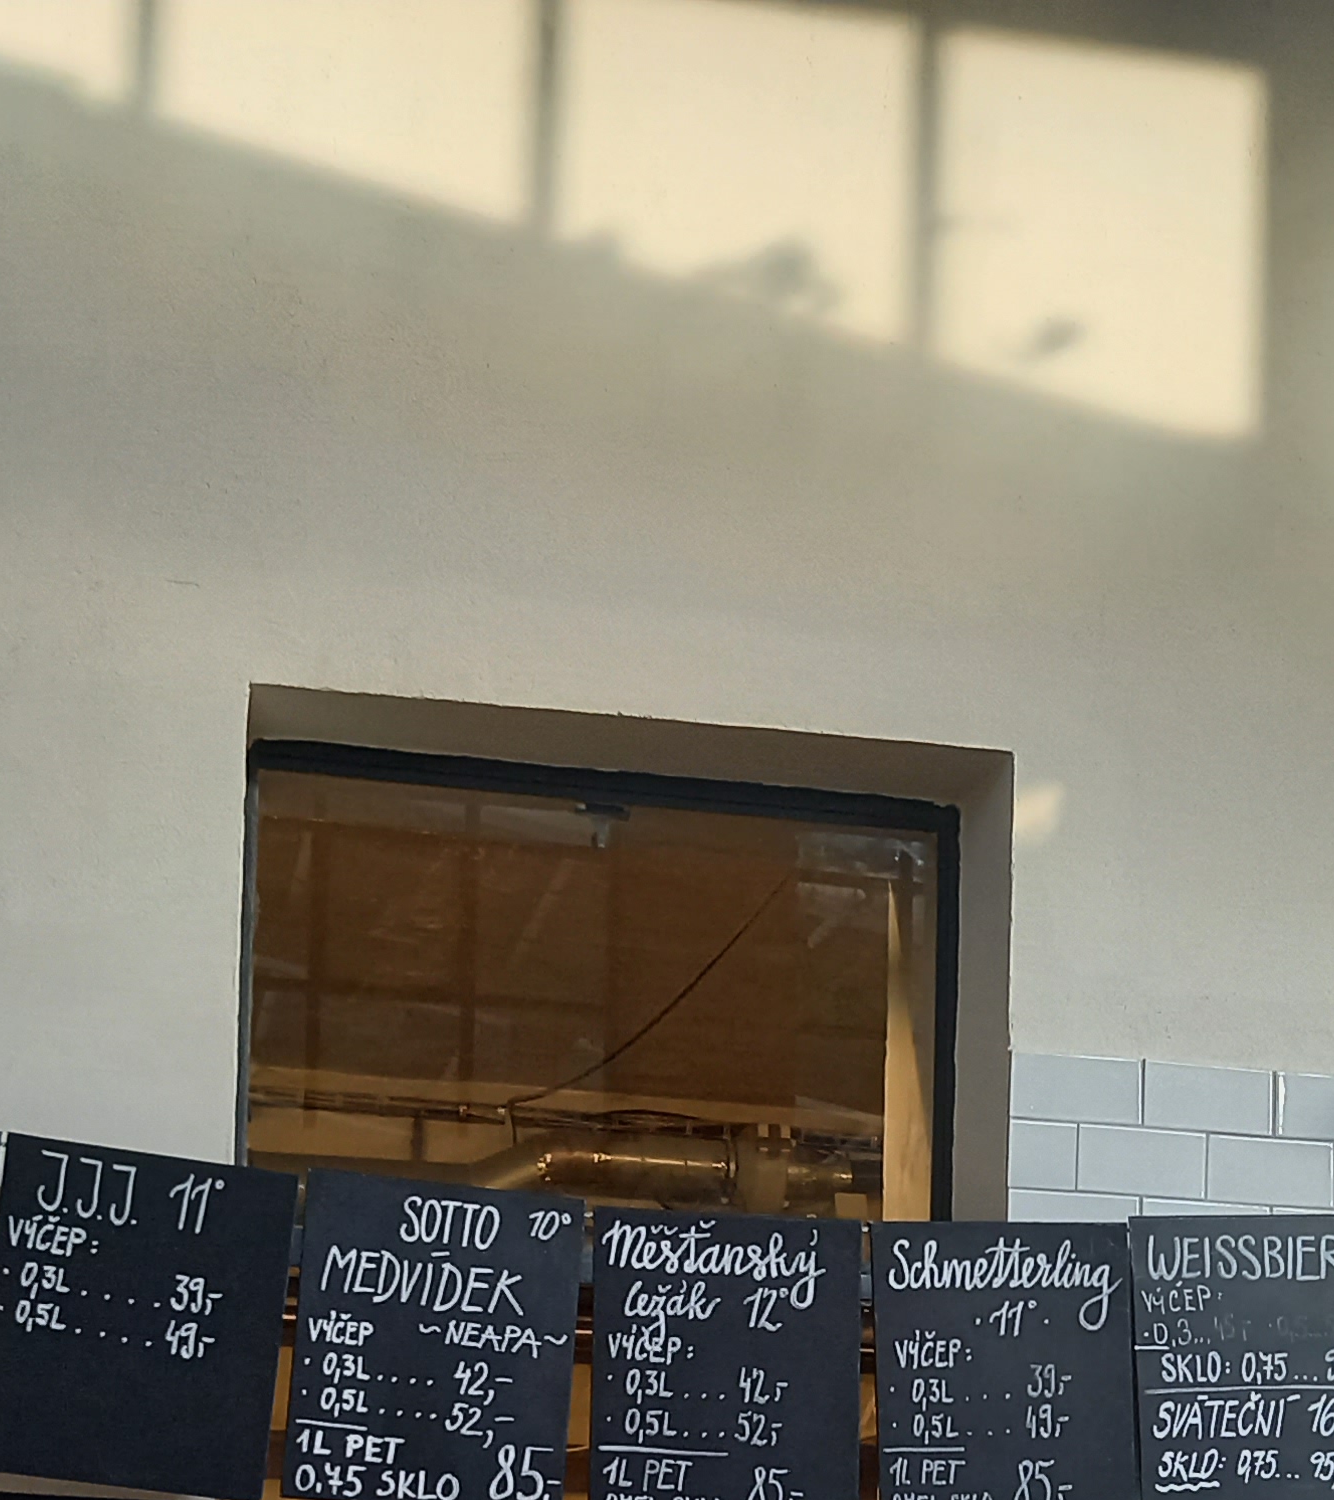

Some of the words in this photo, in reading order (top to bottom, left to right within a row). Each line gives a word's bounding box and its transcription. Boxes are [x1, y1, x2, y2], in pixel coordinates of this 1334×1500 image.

[400, 1196, 500, 1250] SOTTO
[529, 1211, 571, 1240] 10°
[21, 1262, 70, 1297] 0,3L
[321, 1245, 523, 1321] MEDVÍDEK
[889, 1237, 1122, 1335] Schmetterling
[16, 1300, 66, 1332] 0,5L
[743, 1288, 789, 1331] 12°
[309, 1310, 373, 1346] VÝČEP
[323, 1352, 370, 1384] 0,3L
[1242, 1352, 1288, 1384] 0,75
[321, 1387, 368, 1417] 0,5L
[626, 1369, 673, 1404] 0,3L
[912, 1379, 953, 1409] 0,3L
[625, 1408, 677, 1443] 0,5L
[914, 1414, 958, 1444] 0,5L
[1153, 1391, 1300, 1440] SVÁTEČNÍ
[296, 1429, 329, 1455] 1L
[346, 1434, 405, 1464] PET
[376, 1470, 459, 1500] SKLO
[603, 1457, 632, 1487] 1L
[643, 1459, 693, 1491] PET
[890, 1457, 910, 1486] 1L
[922, 1459, 965, 1485] PET
